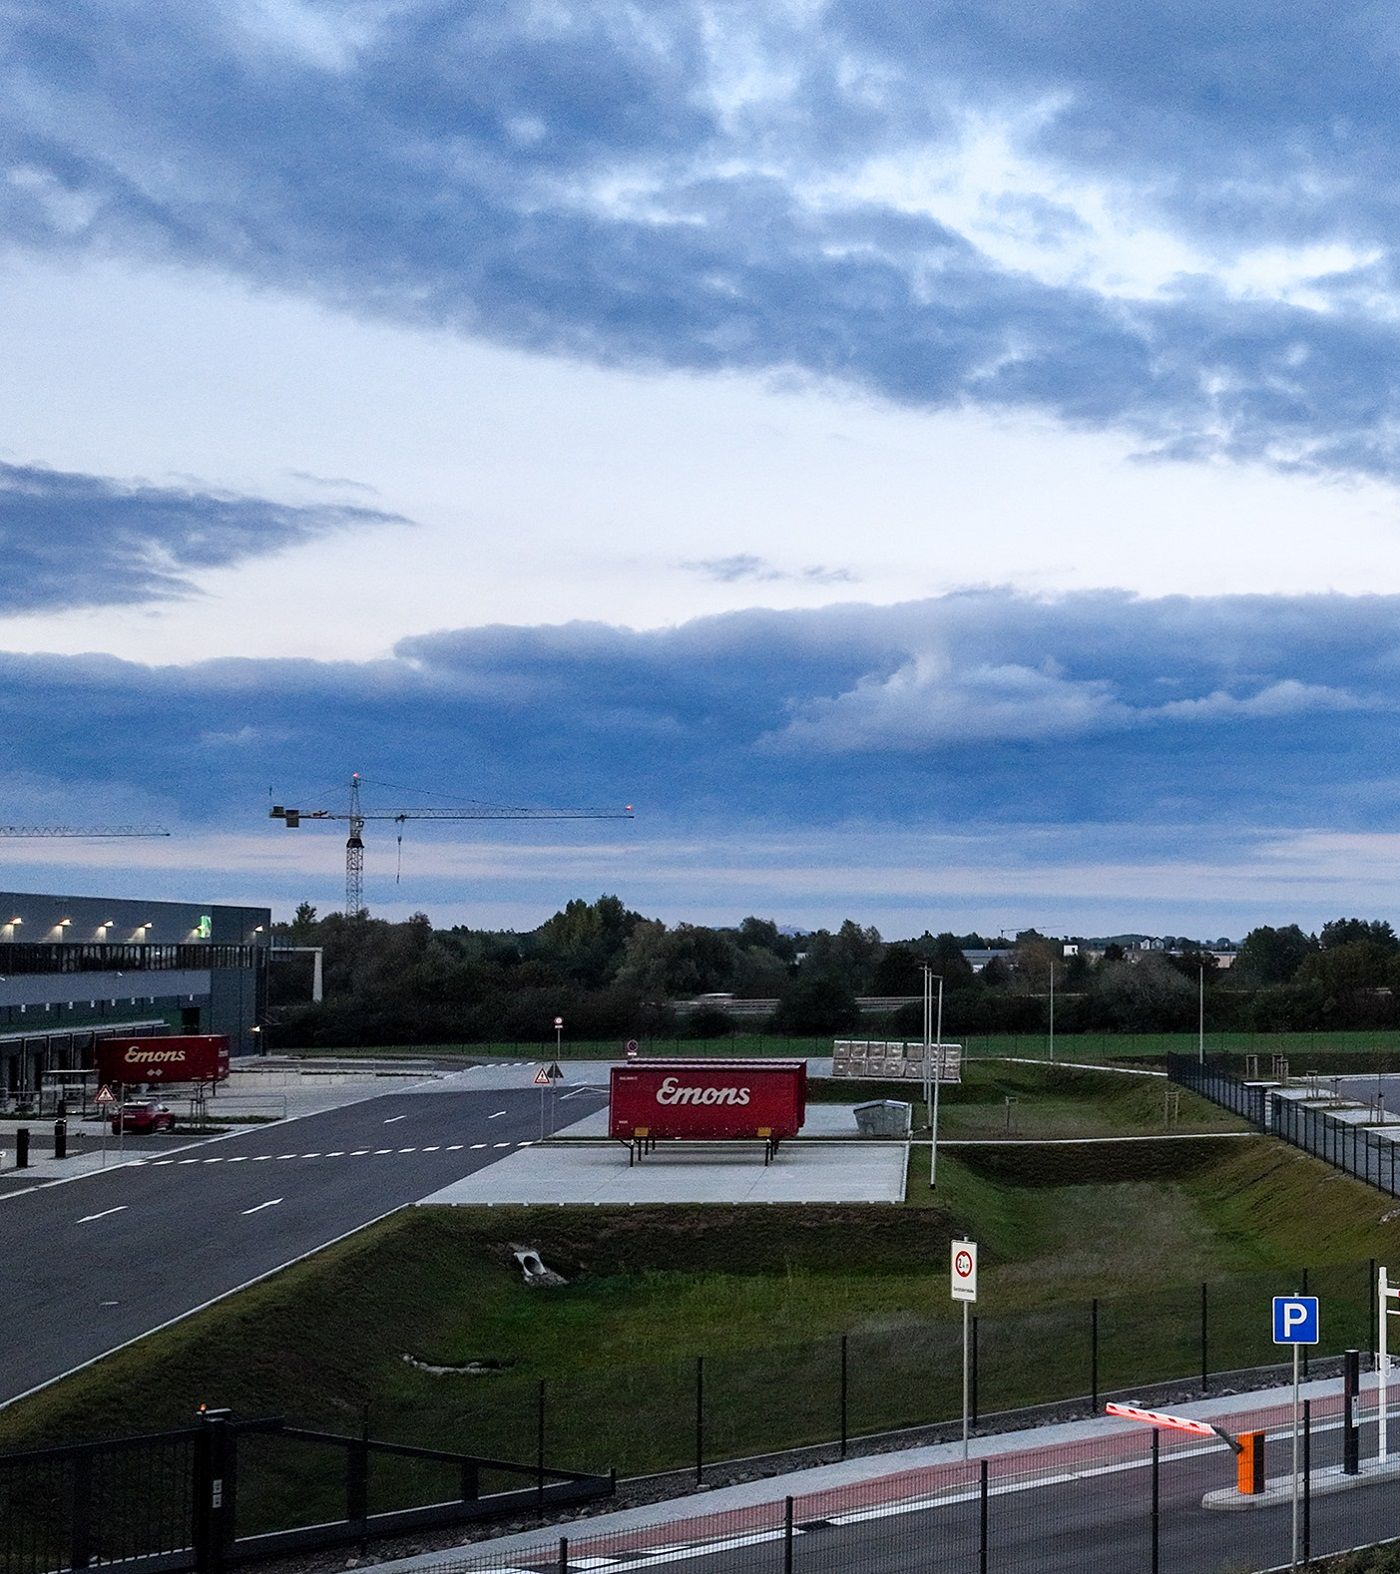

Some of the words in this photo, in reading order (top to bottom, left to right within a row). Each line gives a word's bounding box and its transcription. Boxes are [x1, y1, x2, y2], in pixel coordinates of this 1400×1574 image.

[124, 1046, 186, 1063] Emons
[655, 1077, 751, 1105] Emons
[1284, 1303, 1308, 1337] P
